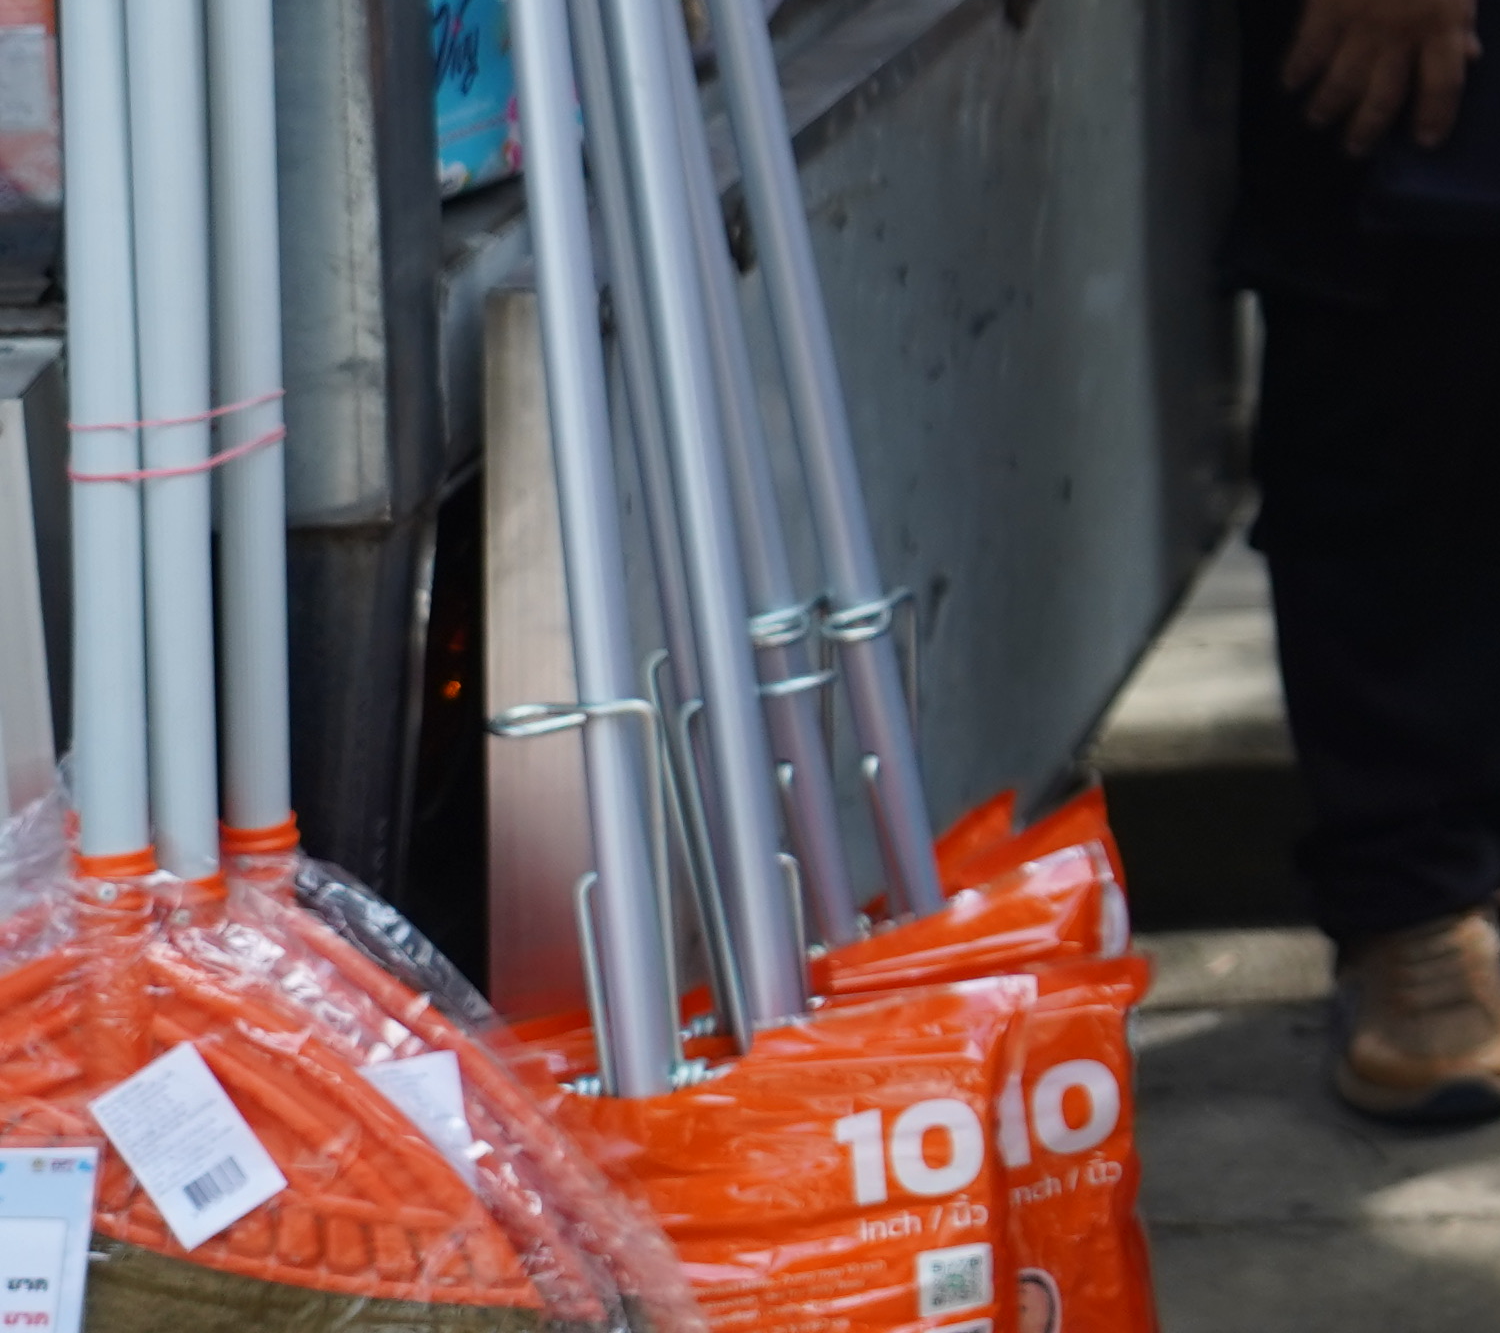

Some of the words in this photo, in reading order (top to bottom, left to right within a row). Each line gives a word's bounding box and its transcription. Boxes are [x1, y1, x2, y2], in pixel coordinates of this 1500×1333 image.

[834, 1096, 986, 1207] 10
[6, 1275, 49, 1293] บาท
[3, 1309, 50, 1329] บาท
